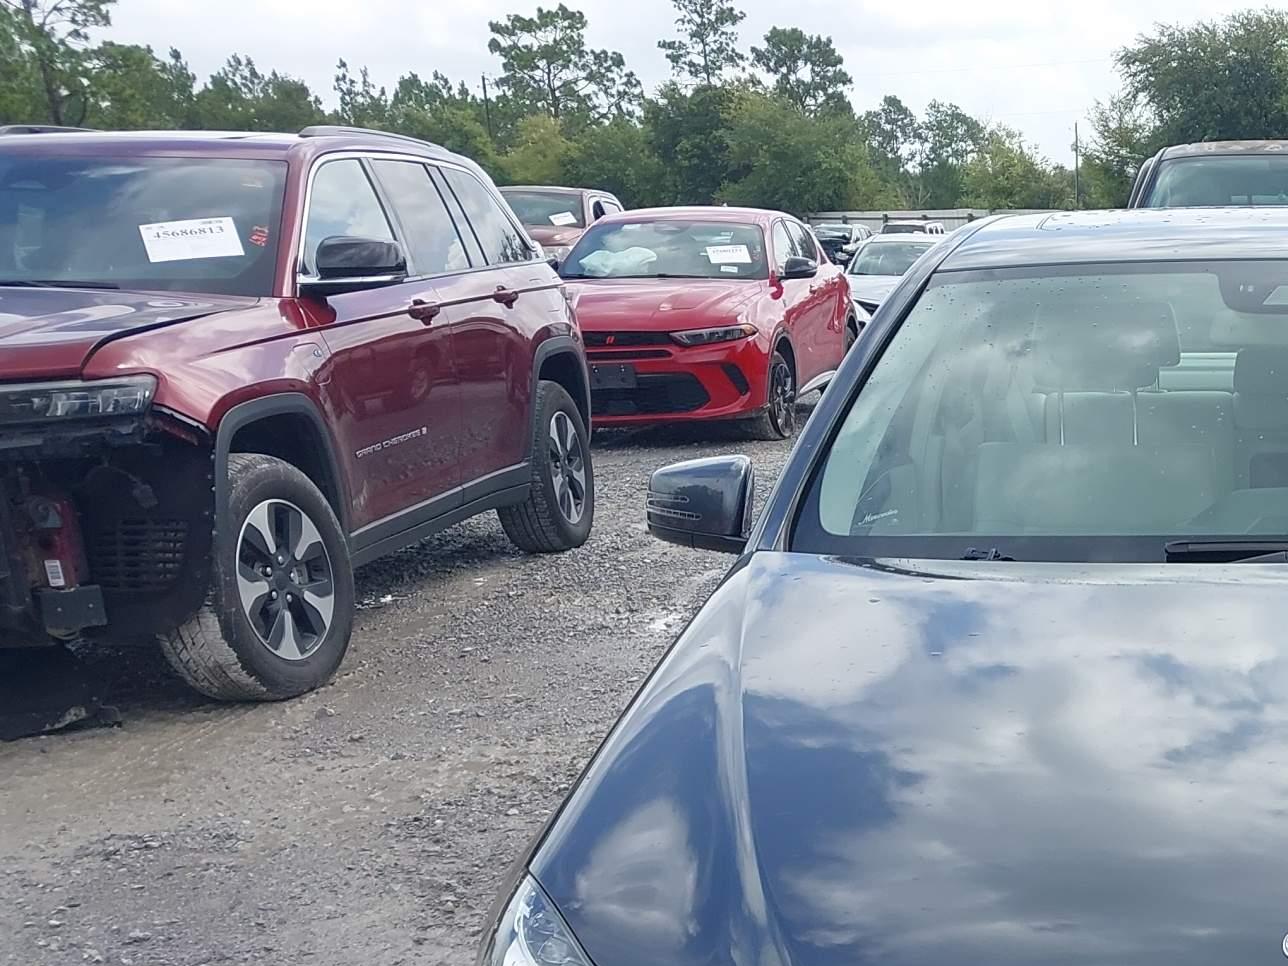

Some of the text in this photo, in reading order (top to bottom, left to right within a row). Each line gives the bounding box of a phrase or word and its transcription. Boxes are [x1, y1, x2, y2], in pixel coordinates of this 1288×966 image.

[153, 225, 225, 240] 45686813
[355, 429, 421, 458] GRAND CHEROKEE
